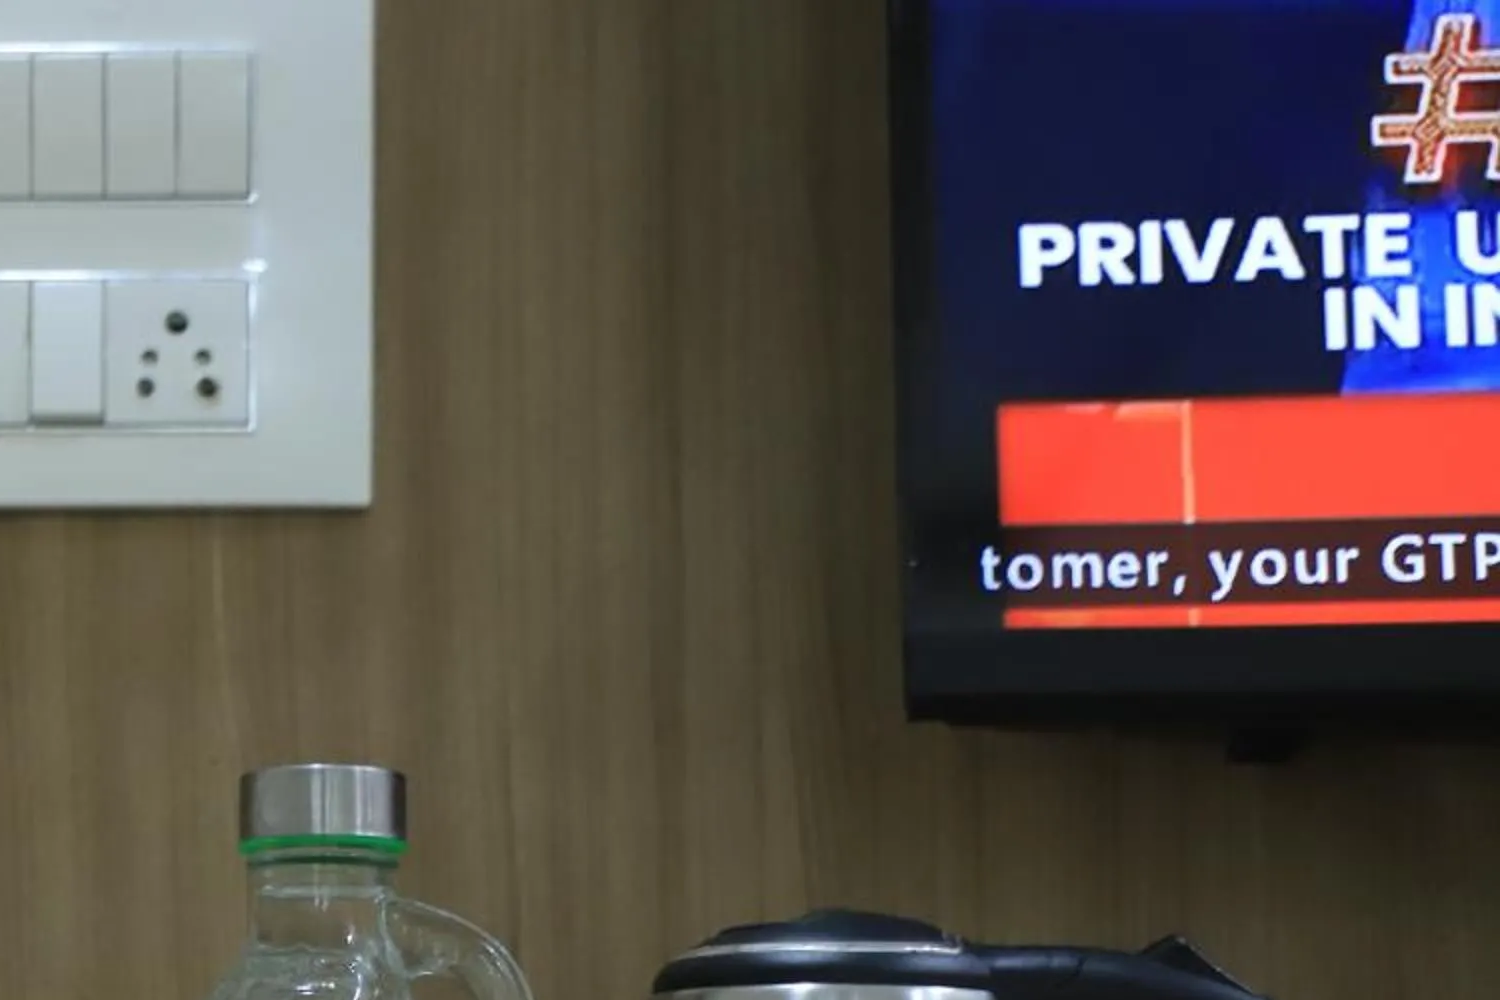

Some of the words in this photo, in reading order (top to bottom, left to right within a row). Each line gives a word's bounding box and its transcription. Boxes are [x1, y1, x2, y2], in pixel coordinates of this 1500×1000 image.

[1018, 212, 1412, 288] PRIVATE
[1323, 284, 1421, 351] IN
[981, 546, 1187, 595] tomer,
[1210, 547, 1360, 601] your
[1381, 532, 1500, 583] GTP
